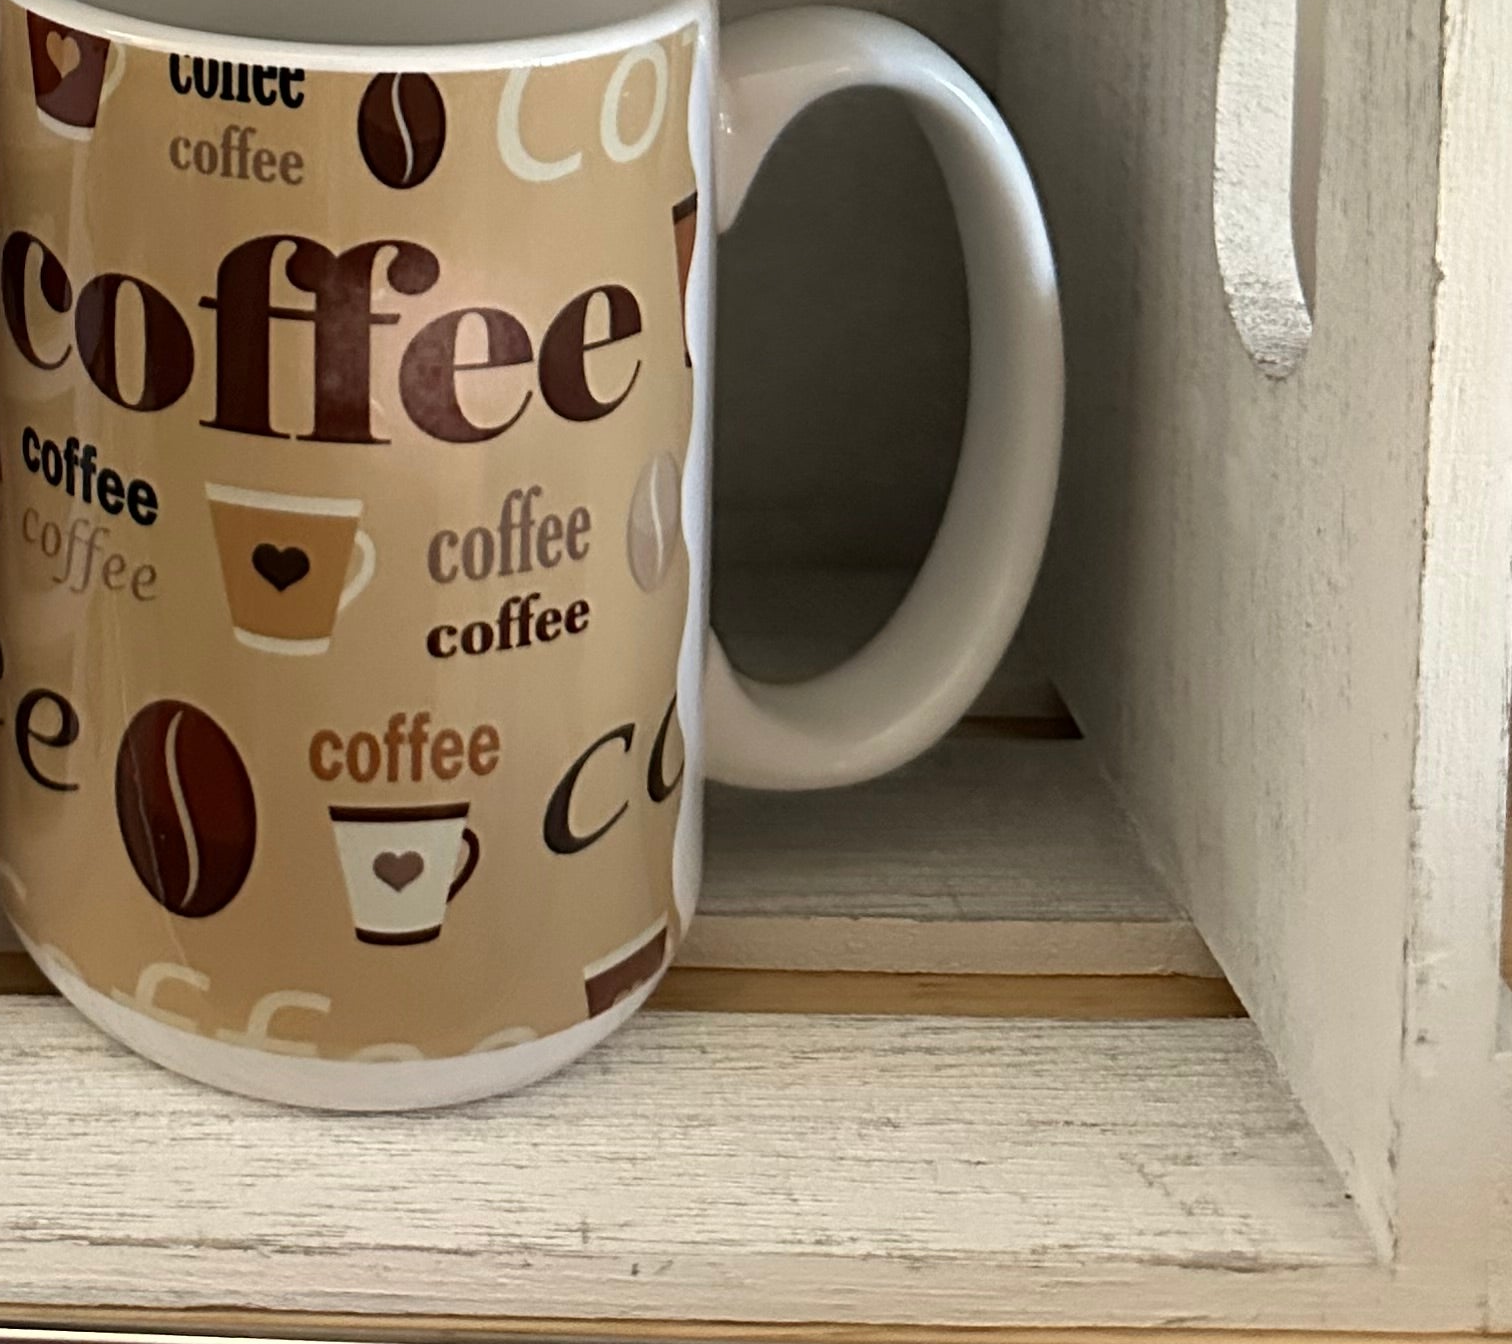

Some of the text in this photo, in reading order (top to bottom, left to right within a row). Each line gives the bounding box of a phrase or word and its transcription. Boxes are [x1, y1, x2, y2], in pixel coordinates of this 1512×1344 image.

[169, 124, 305, 186] coffee
[0, 234, 644, 445] coffee
[22, 425, 159, 527] coffee
[21, 507, 158, 602] coffee
[427, 484, 592, 585] coffee
[426, 592, 591, 659] coffee
[308, 712, 501, 784] coffee
